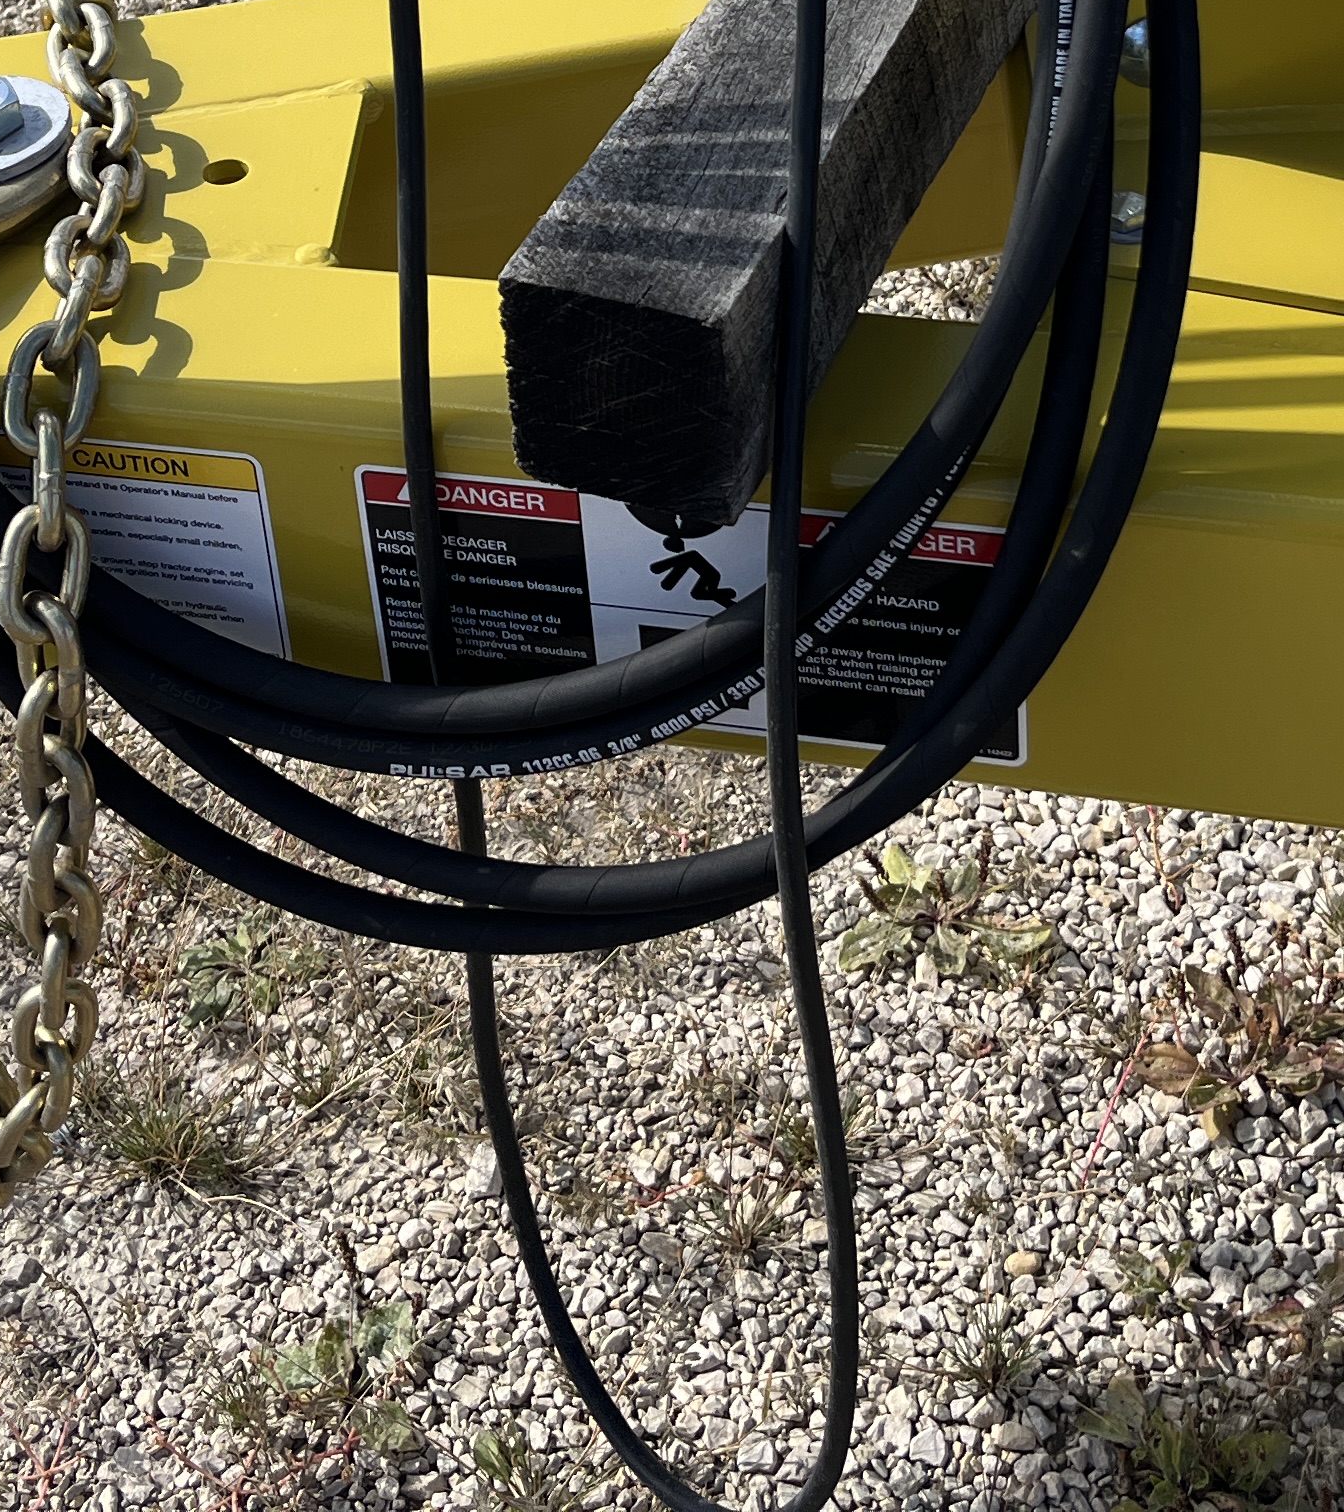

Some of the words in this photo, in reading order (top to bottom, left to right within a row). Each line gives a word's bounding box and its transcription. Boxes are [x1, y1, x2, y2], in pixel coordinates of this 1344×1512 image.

[1057, 27, 1071, 44] IN
[72, 449, 190, 477] CAUTION
[65, 479, 101, 489] erstand
[119, 483, 169, 497] Operator's
[171, 490, 205, 500] Manual
[207, 493, 238, 504] before
[99, 510, 152, 522] mechanical
[375, 528, 418, 542] LAISS
[917, 532, 976, 556] GER
[456, 551, 517, 567] DANGER
[380, 564, 407, 577] Peut
[527, 580, 584, 595] blessures
[876, 594, 940, 612] HAZARD
[387, 608, 424, 620] tracteu
[478, 619, 507, 629] vous
[388, 618, 425, 631] baisse
[479, 607, 528, 621] machine
[546, 613, 561, 624] du
[862, 617, 907, 631] serious
[910, 622, 944, 636] injury
[390, 630, 428, 641] mouve
[535, 645, 588, 659] soudains
[392, 640, 429, 651] peuve
[831, 647, 864, 660] away
[866, 649, 895, 662] from
[389, 762, 513, 780] PULSAR
[522, 746, 603, 776] 112CC-06
[607, 731, 644, 758] 3/8"
[650, 709, 692, 743] 4800
[692, 694, 720, 721] PSI
[727, 674, 758, 705] 330
[813, 577, 874, 634] EXCEEDS
[865, 549, 898, 581] SAE
[840, 657, 873, 670] when
[876, 662, 918, 677] raising
[798, 675, 862, 691] movement
[865, 682, 888, 693] can
[891, 685, 926, 697] result
[827, 666, 874, 681] Sudden
[877, 672, 935, 688] unexpect
